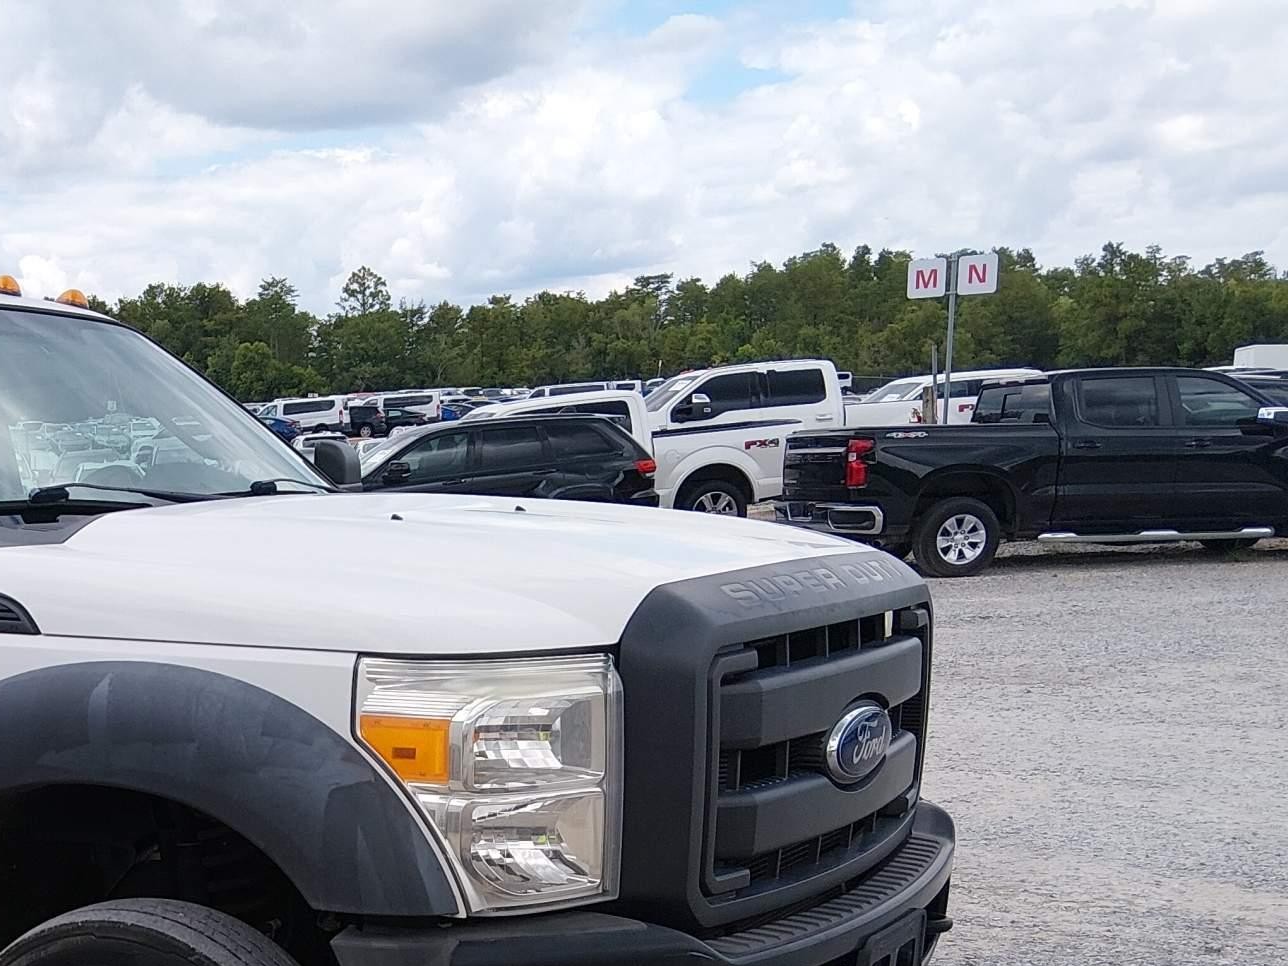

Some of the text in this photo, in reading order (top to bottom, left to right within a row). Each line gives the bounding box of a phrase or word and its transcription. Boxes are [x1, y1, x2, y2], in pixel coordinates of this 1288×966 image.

[915, 269, 938, 289] M
[968, 263, 987, 284] N
[720, 559, 903, 607] SUPER DUTY
[852, 720, 886, 764] Ford
